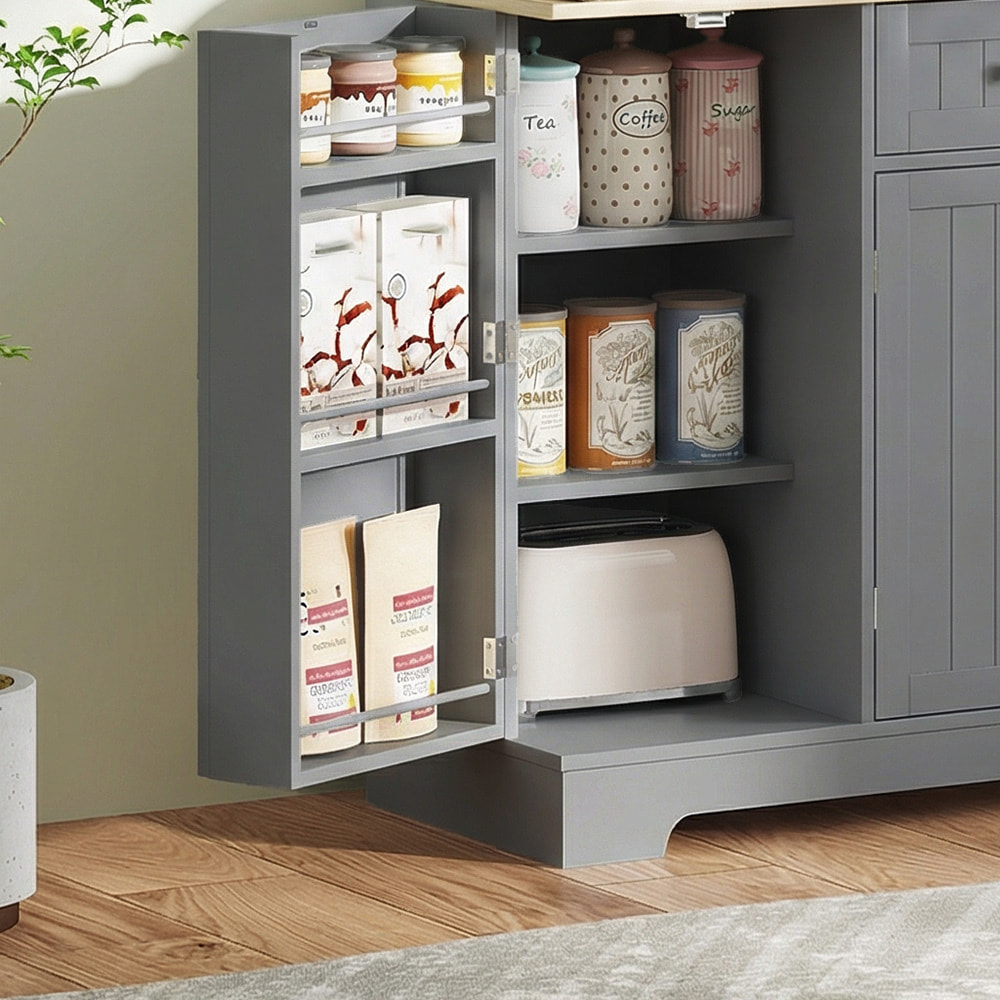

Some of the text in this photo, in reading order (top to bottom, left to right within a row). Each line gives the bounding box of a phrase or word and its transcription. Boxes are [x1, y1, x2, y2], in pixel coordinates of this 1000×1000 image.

[618, 108, 666, 130] Coffee
[710, 102, 756, 122] Sugar
[522, 114, 557, 131] Tea
